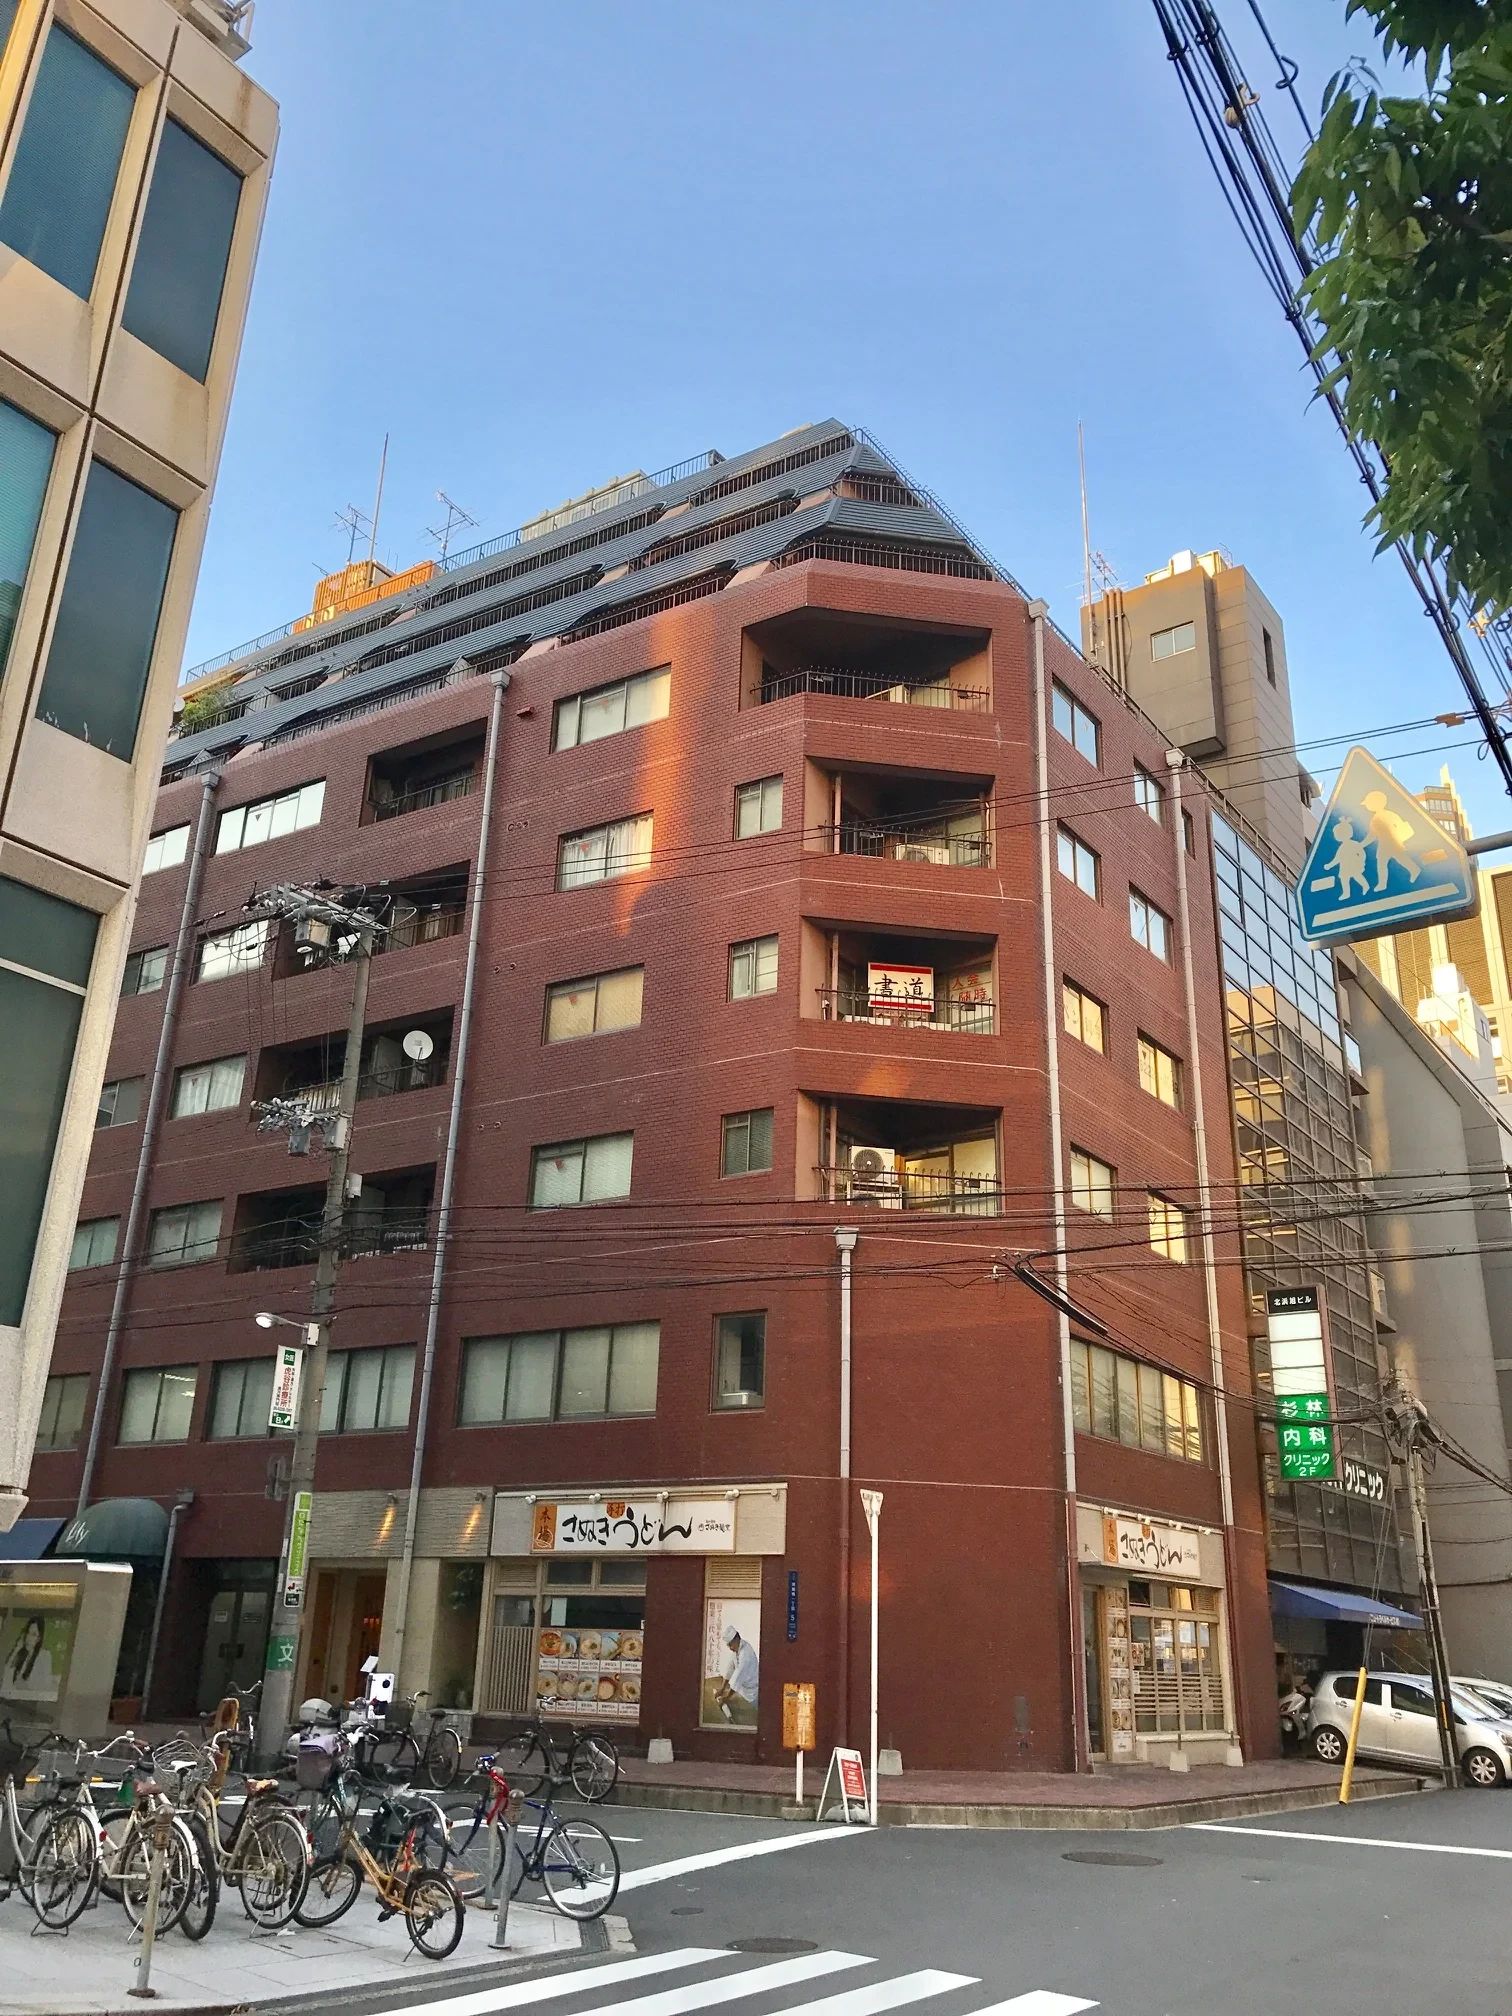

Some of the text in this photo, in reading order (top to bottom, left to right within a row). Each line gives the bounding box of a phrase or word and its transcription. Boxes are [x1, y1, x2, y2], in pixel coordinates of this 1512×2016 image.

[874, 974, 924, 998] 書道
[1283, 1428, 1327, 1447] 内科
[1283, 1452, 1330, 1466] クリニック
[1299, 1467, 1317, 1477] 2F
[537, 1506, 553, 1545] 本場
[562, 1506, 694, 1549] さぬきうどん
[1120, 1529, 1183, 1570] さぬきうどん
[278, 1643, 294, 1663] 文
